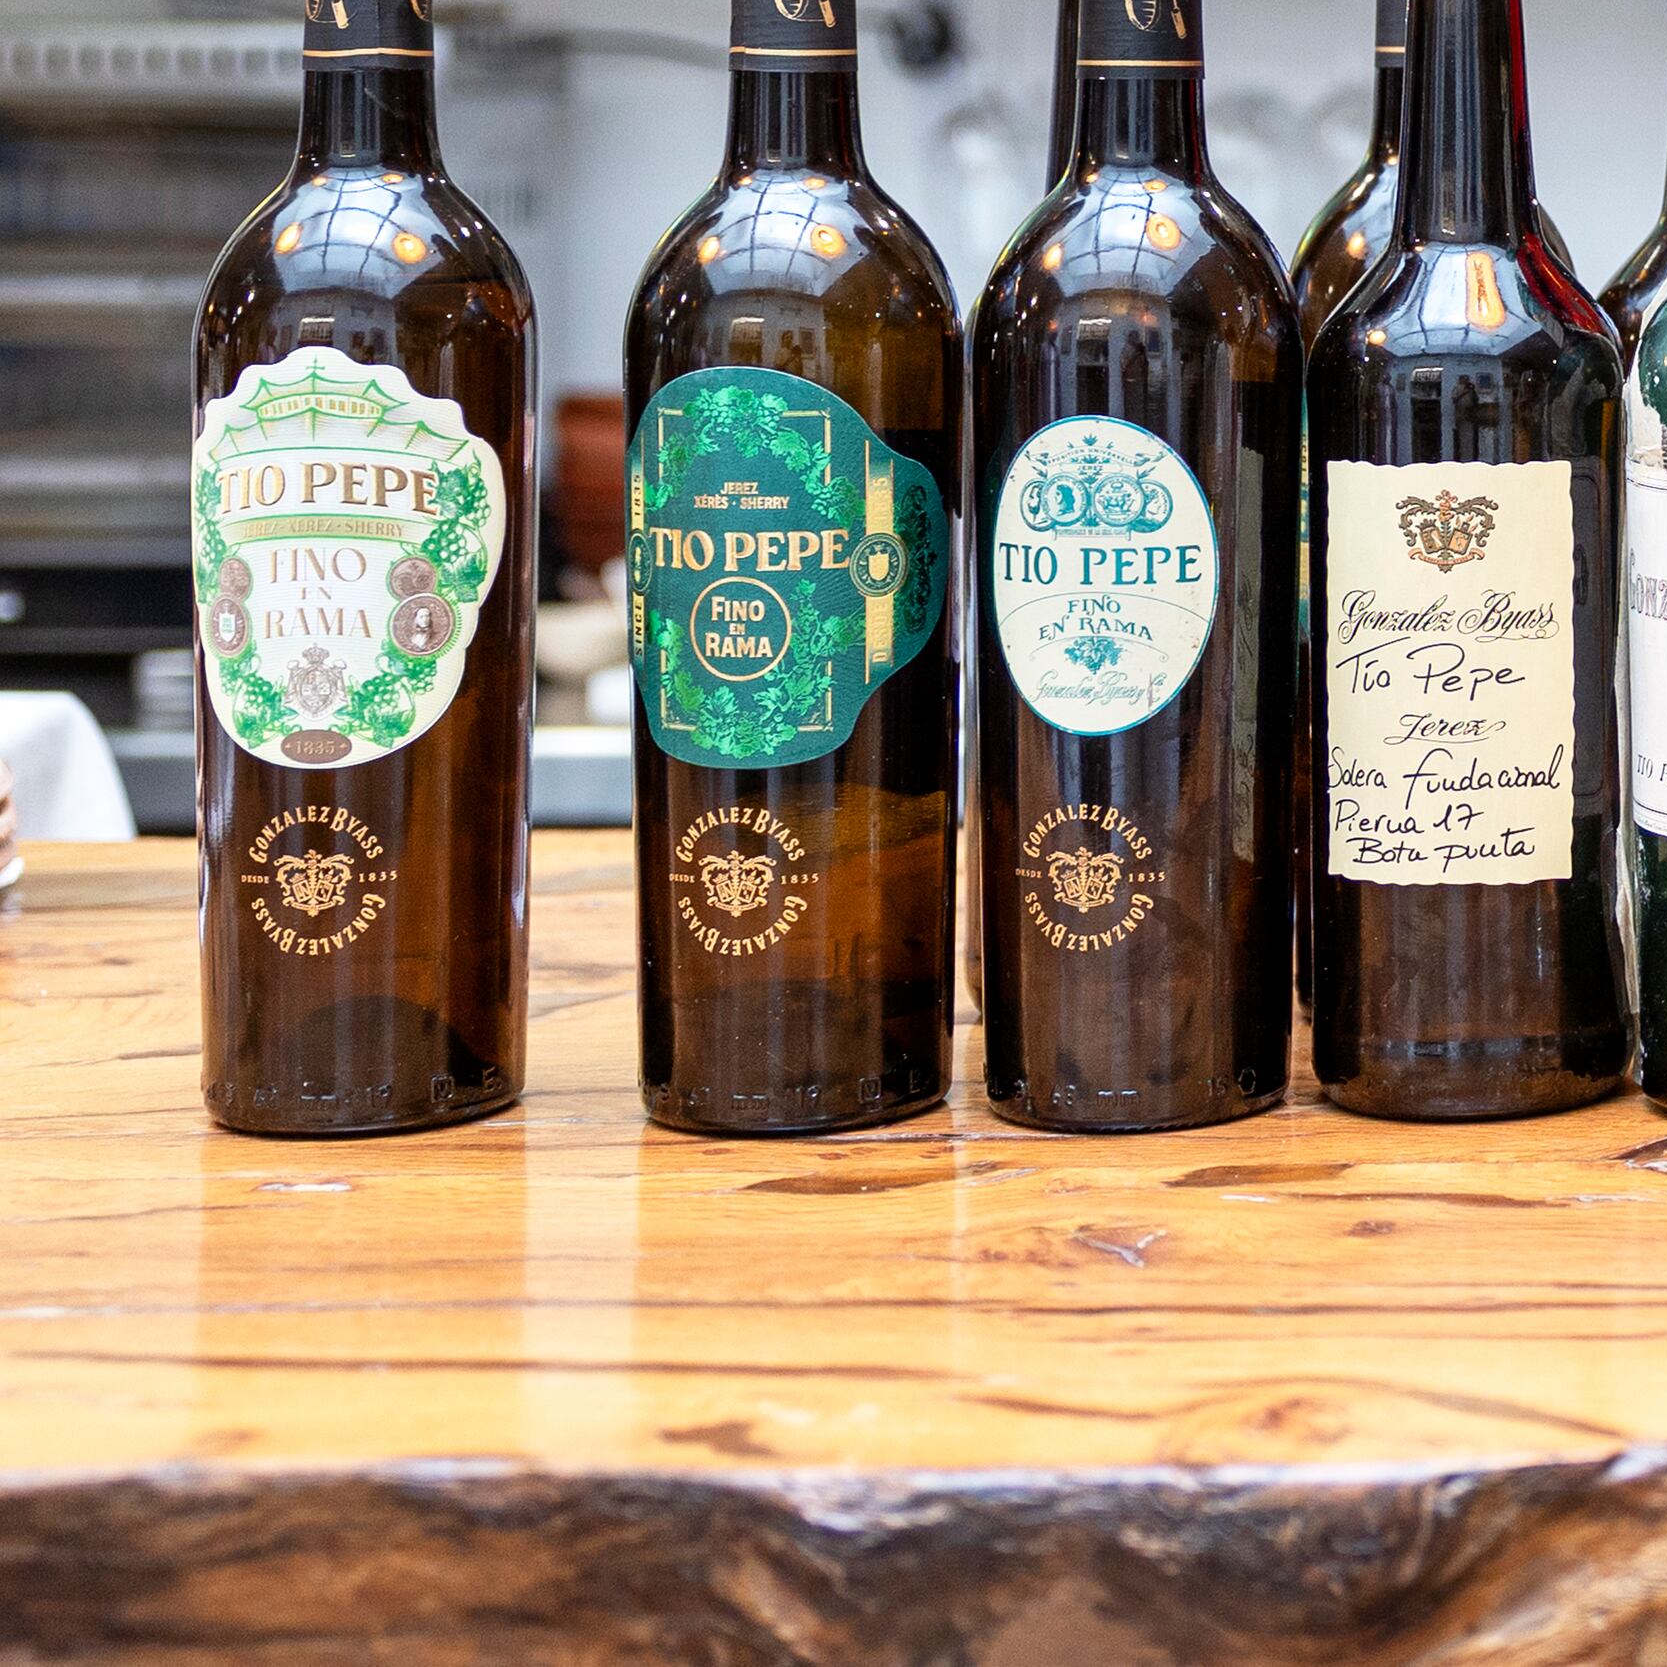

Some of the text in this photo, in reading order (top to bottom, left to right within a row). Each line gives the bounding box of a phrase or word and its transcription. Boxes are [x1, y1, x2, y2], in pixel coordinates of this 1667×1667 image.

[216, 460, 439, 517] TIO PEPE
[720, 481, 759, 495] JEREZ
[739, 495, 790, 509] SHERRY
[345, 518, 405, 538] SHERRY
[648, 526, 851, 573] TIO PEPE
[998, 542, 1203, 585] TIO PEPE
[269, 546, 368, 584] FINO
[299, 586, 333, 601] EN
[1067, 594, 1121, 615] FINO
[263, 606, 373, 640] RAMA
[710, 596, 766, 623] FINO
[1338, 589, 1559, 645] Gonzalez Byass
[729, 622, 746, 636] EN
[1079, 617, 1153, 642] RAMA
[705, 632, 774, 660] RAMA
[1406, 642, 1526, 701] Pepe
[1384, 713, 1506, 744] Jerez
[1328, 745, 1388, 791] Solera
[1636, 754, 1654, 780] TIO
[1022, 803, 1152, 860] GONZALEZ BYASS
[1433, 804, 1484, 832] 17
[248, 805, 384, 864] GONZALEZ BYASS
[675, 807, 805, 862] GONZALEZ BYASS
[240, 870, 398, 884] DESDE 1835
[781, 872, 820, 884] 1835
[1127, 871, 1166, 883] 1835
